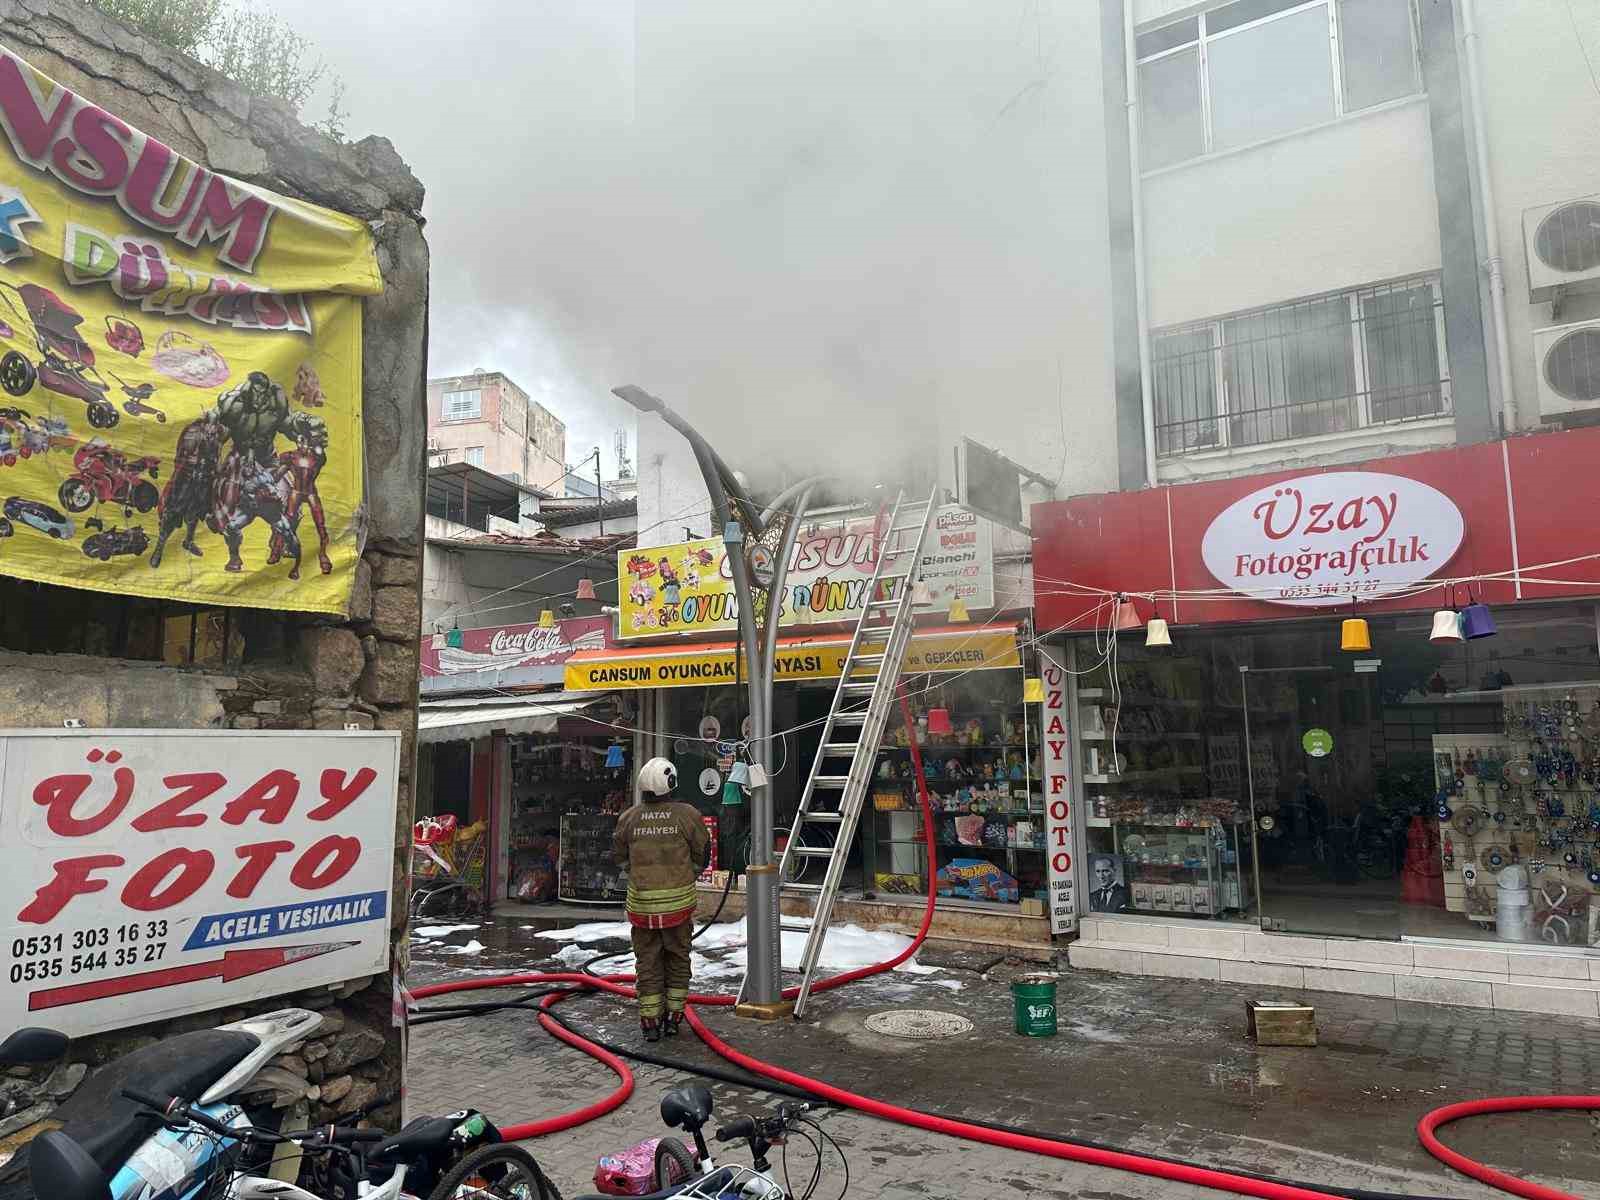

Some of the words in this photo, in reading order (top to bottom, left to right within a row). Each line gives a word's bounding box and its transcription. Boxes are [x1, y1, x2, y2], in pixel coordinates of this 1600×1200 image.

[1253, 487, 1397, 544] Üzay
[922, 551, 975, 565] Bianchi
[1235, 536, 1430, 580] Fotoğrafçılık
[490, 624, 562, 656] Coca-Cola
[589, 667, 651, 683] CANSUM
[658, 660, 736, 680] OYUNCAK
[33, 748, 377, 837] ÜZAY
[641, 811, 672, 820] HATAY
[1050, 775, 1072, 873] FOTO
[17, 835, 361, 924] FOTO
[11, 934, 63, 958] 0531
[72, 929, 109, 951] 303
[116, 924, 139, 944] 16
[146, 919, 168, 939] 33
[206, 914, 271, 942] ACELE
[9, 959, 62, 983] 0535
[70, 953, 107, 974] 544
[114, 948, 137, 968] 35
[144, 942, 167, 962] 27
